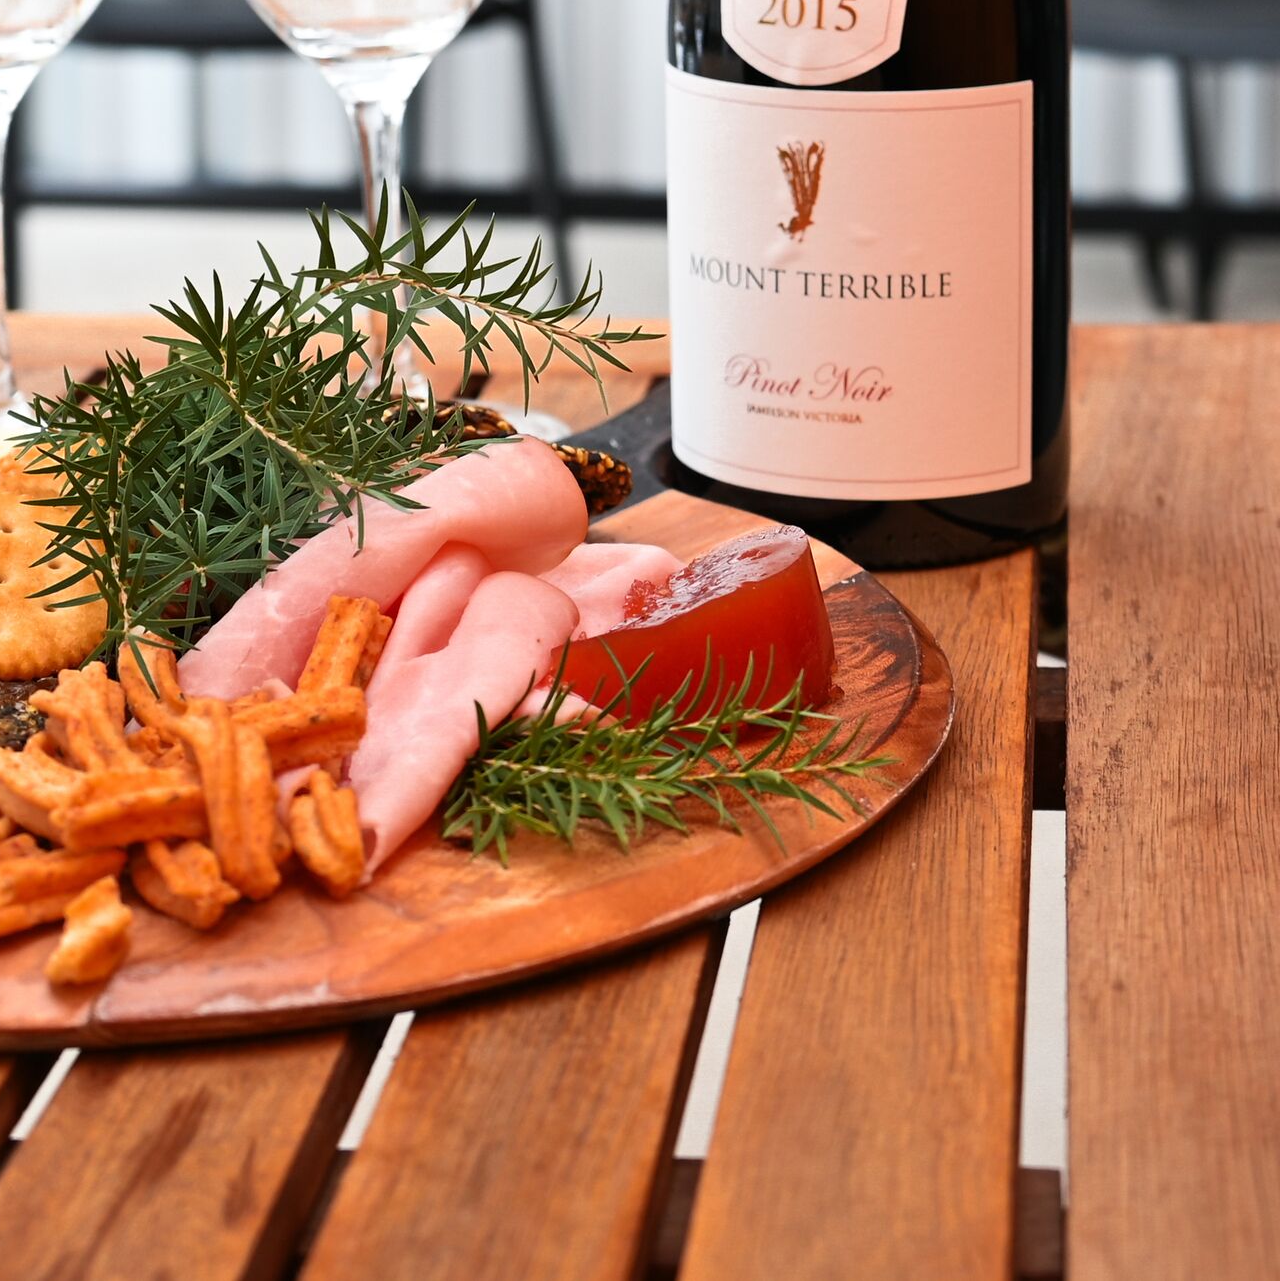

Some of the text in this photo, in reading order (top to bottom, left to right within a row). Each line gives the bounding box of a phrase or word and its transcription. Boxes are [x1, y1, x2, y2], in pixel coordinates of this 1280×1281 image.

[690, 253, 952, 299] MOUNT TERRIBLE
[724, 353, 893, 402] Pinot Noir
[802, 410, 862, 424] VICTORIA
